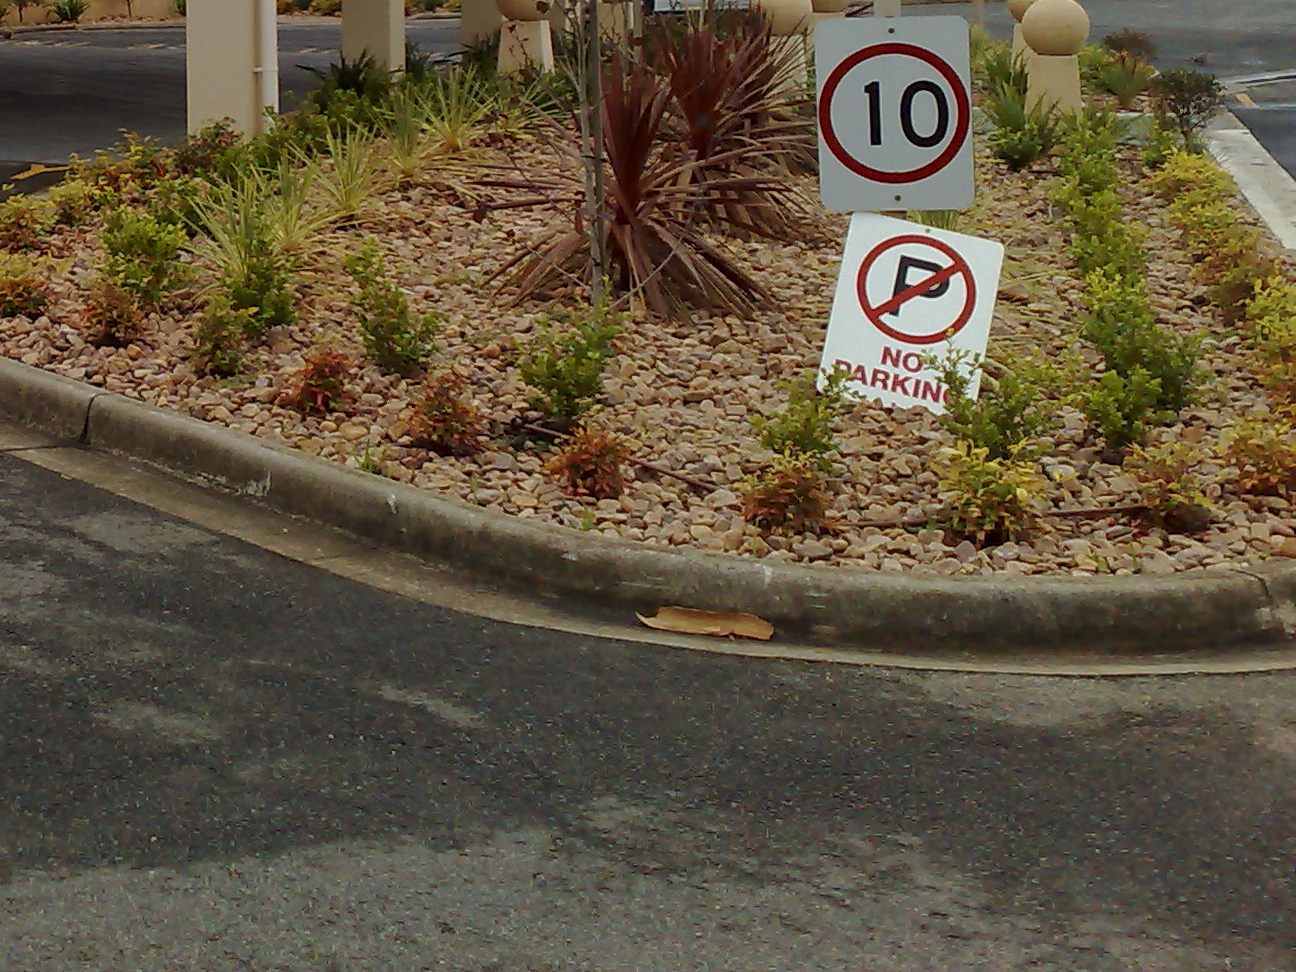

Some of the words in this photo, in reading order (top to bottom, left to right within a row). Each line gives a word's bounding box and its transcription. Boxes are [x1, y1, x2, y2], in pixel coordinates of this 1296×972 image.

[863, 79, 950, 149] 10
[889, 254, 951, 317] P
[880, 346, 925, 373] NO
